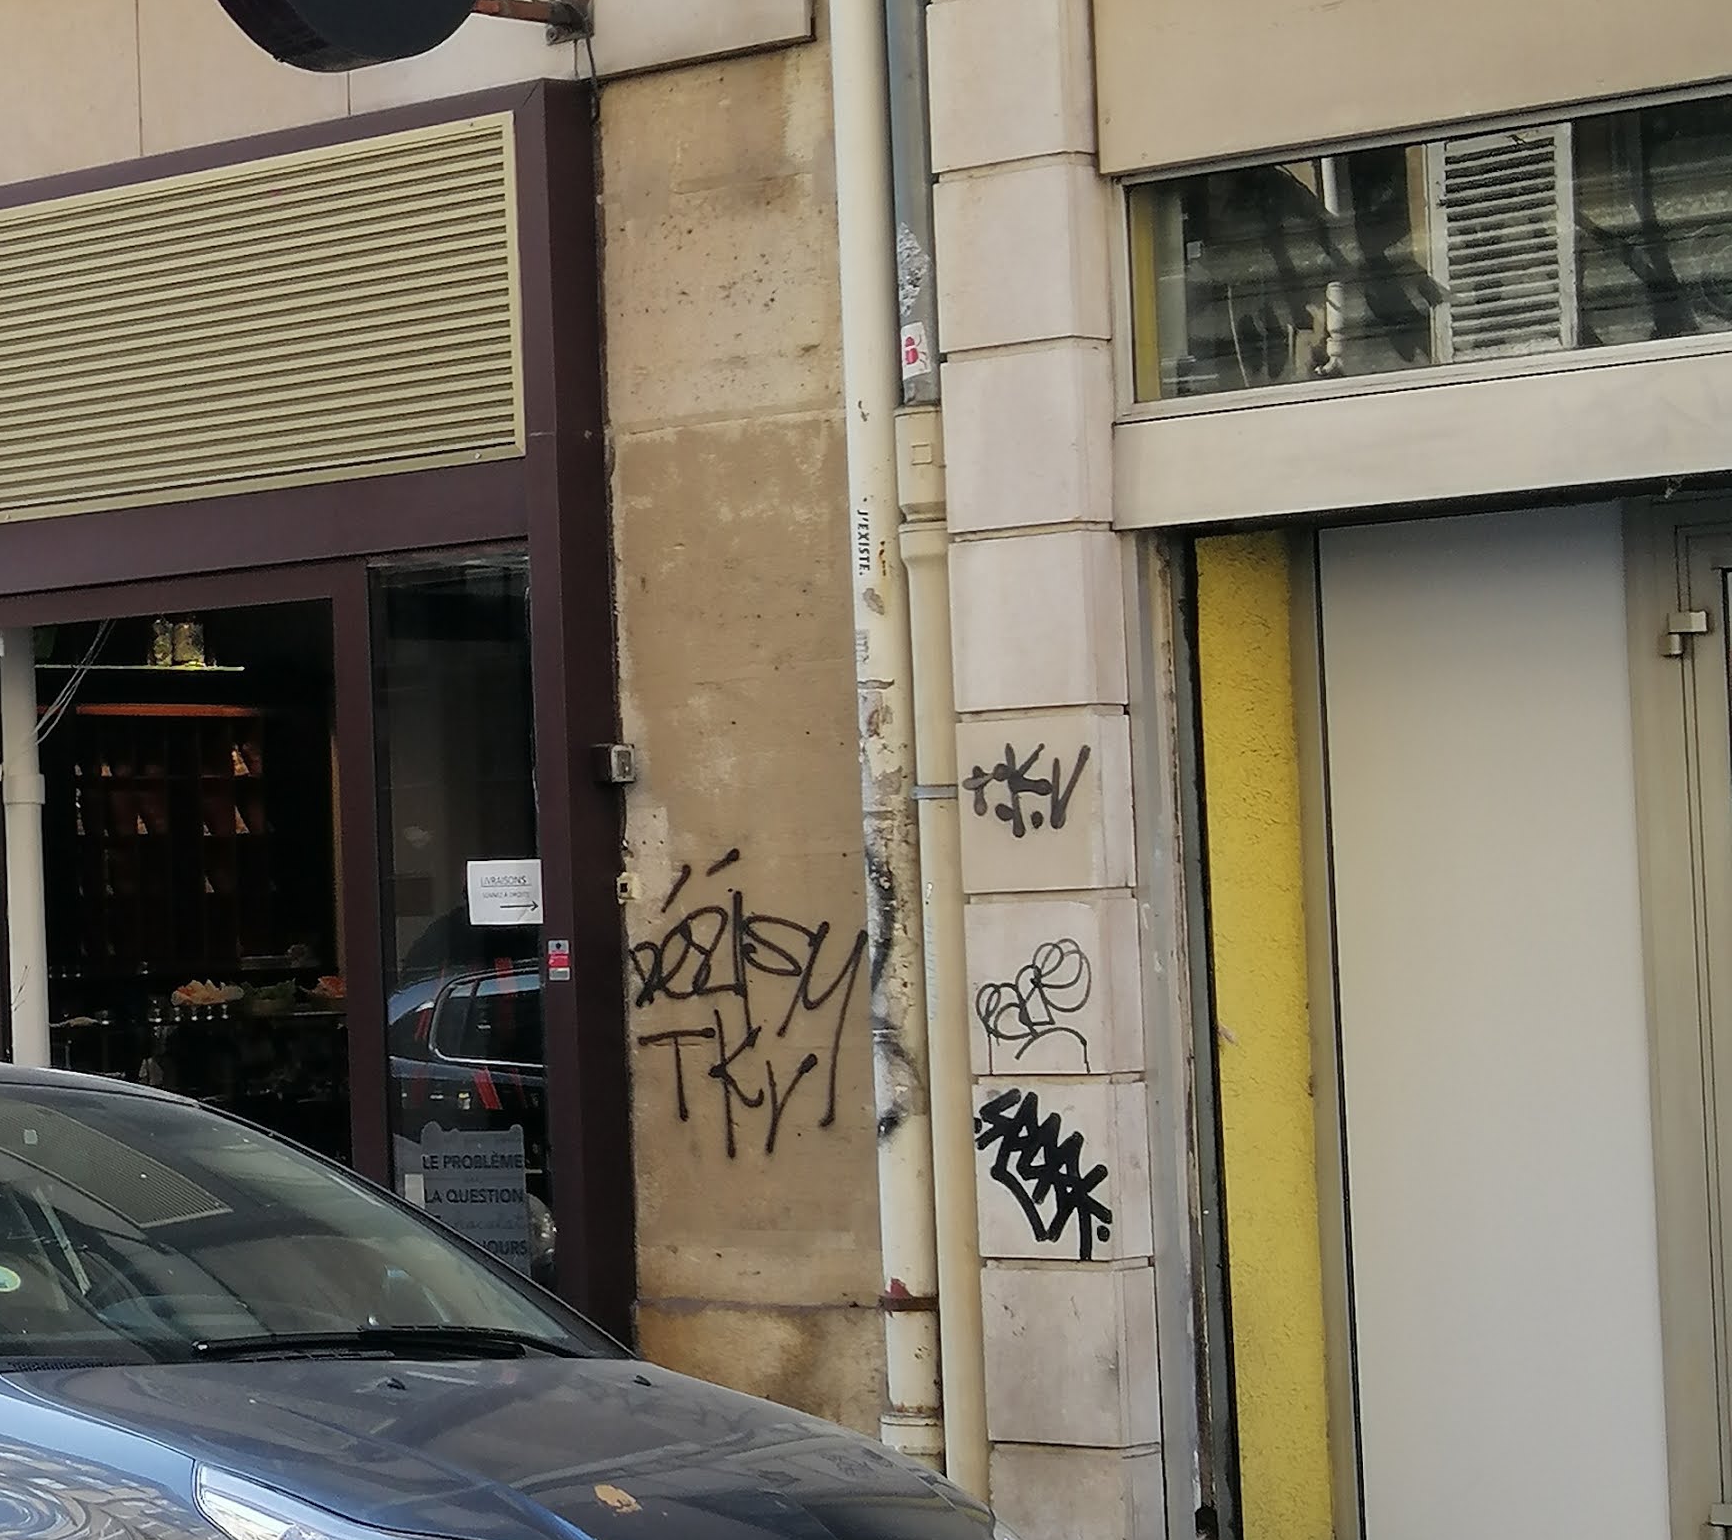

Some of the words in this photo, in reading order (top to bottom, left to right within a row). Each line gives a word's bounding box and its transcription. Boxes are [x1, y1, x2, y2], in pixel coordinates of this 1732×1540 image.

[421, 1154, 440, 1170] LE
[443, 1150, 524, 1170] PROBLÈME
[424, 1188, 443, 1204] LA
[445, 1188, 524, 1204] QUESTION
